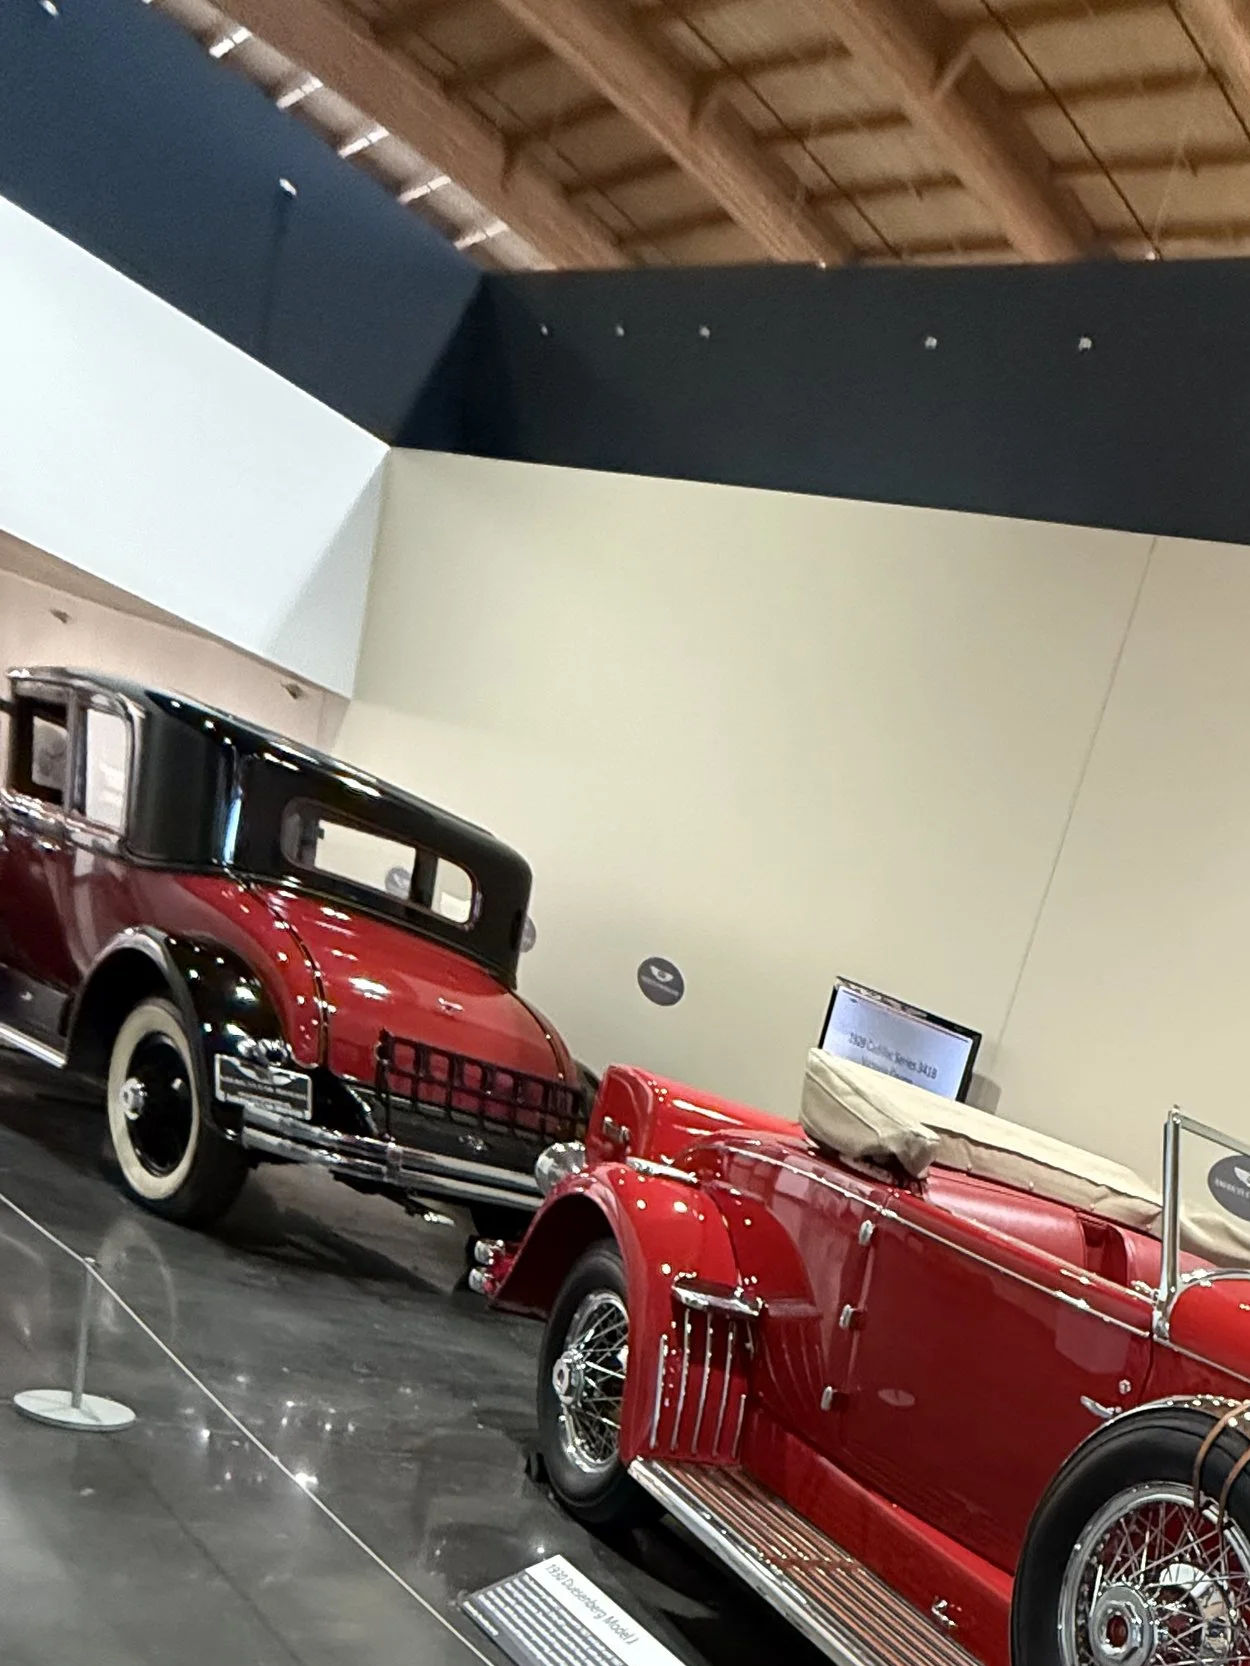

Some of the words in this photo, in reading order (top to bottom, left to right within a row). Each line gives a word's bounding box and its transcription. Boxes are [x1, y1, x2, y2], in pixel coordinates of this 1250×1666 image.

[894, 1051, 917, 1071] Series
[561, 1577, 607, 1620] Duesenberg
[602, 1615, 636, 1641] Model
